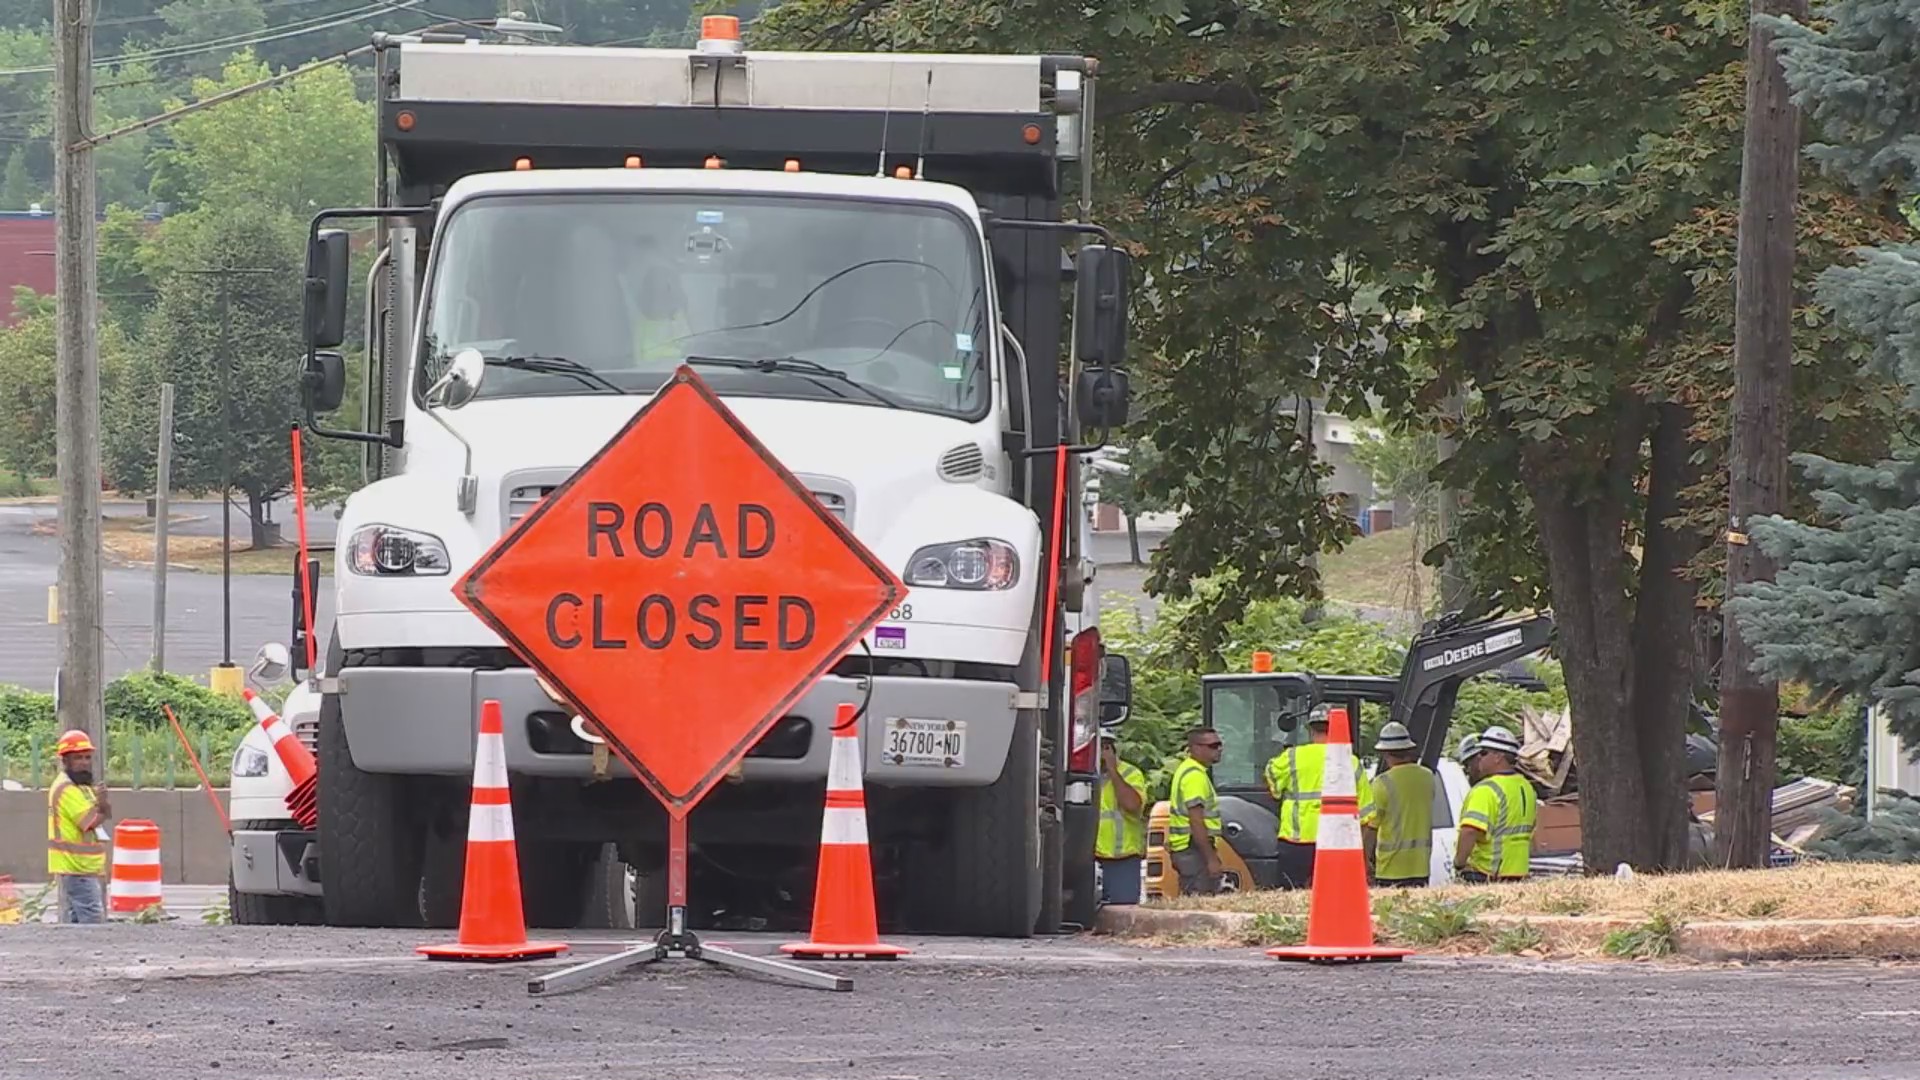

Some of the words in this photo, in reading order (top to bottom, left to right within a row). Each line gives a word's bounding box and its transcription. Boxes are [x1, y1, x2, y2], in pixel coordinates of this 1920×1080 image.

[587, 502, 775, 558] ROAD
[545, 592, 816, 651] CLOSED
[1444, 642, 1485, 665] DEERE
